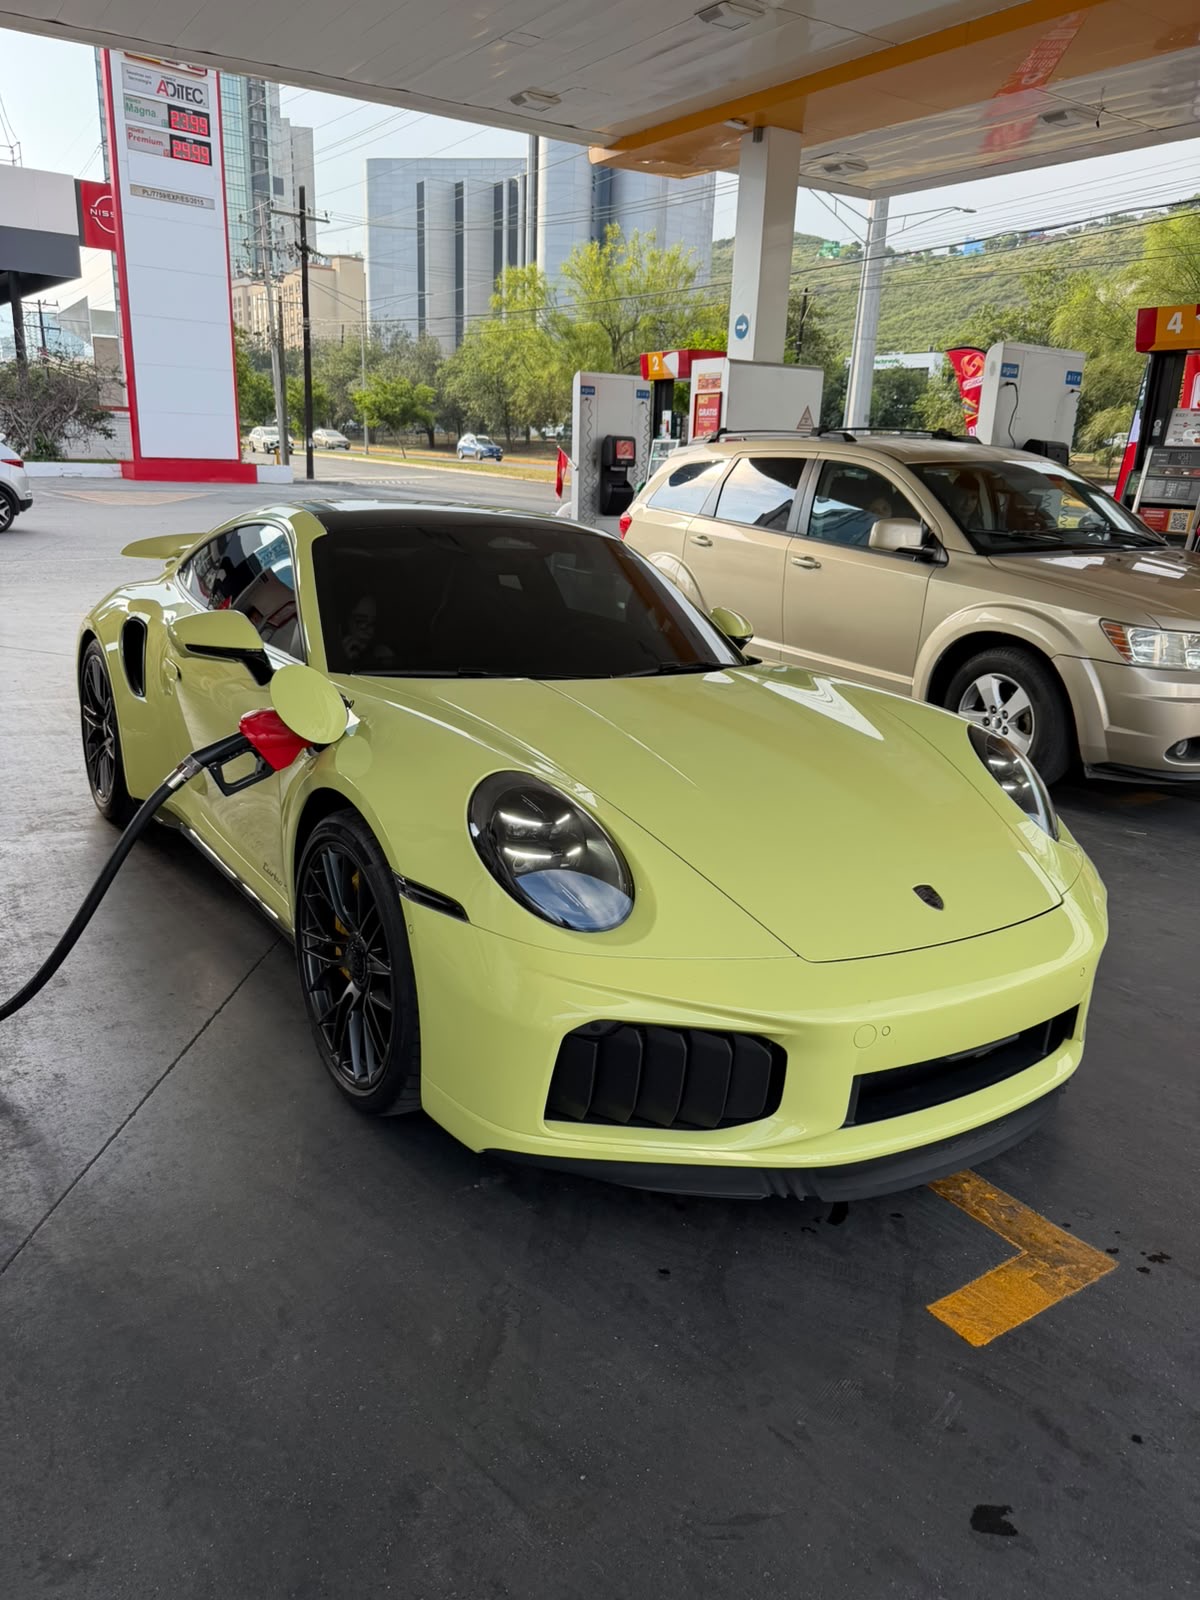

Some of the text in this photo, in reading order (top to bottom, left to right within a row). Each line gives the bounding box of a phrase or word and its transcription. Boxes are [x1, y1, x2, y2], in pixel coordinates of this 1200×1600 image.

[125, 102, 157, 117] Magna
[127, 132, 164, 147] Premium
[1166, 311, 1184, 334] 4
[653, 355, 660, 371] 2
[1002, 366, 1018, 376] agua
[1067, 374, 1081, 382] aire
